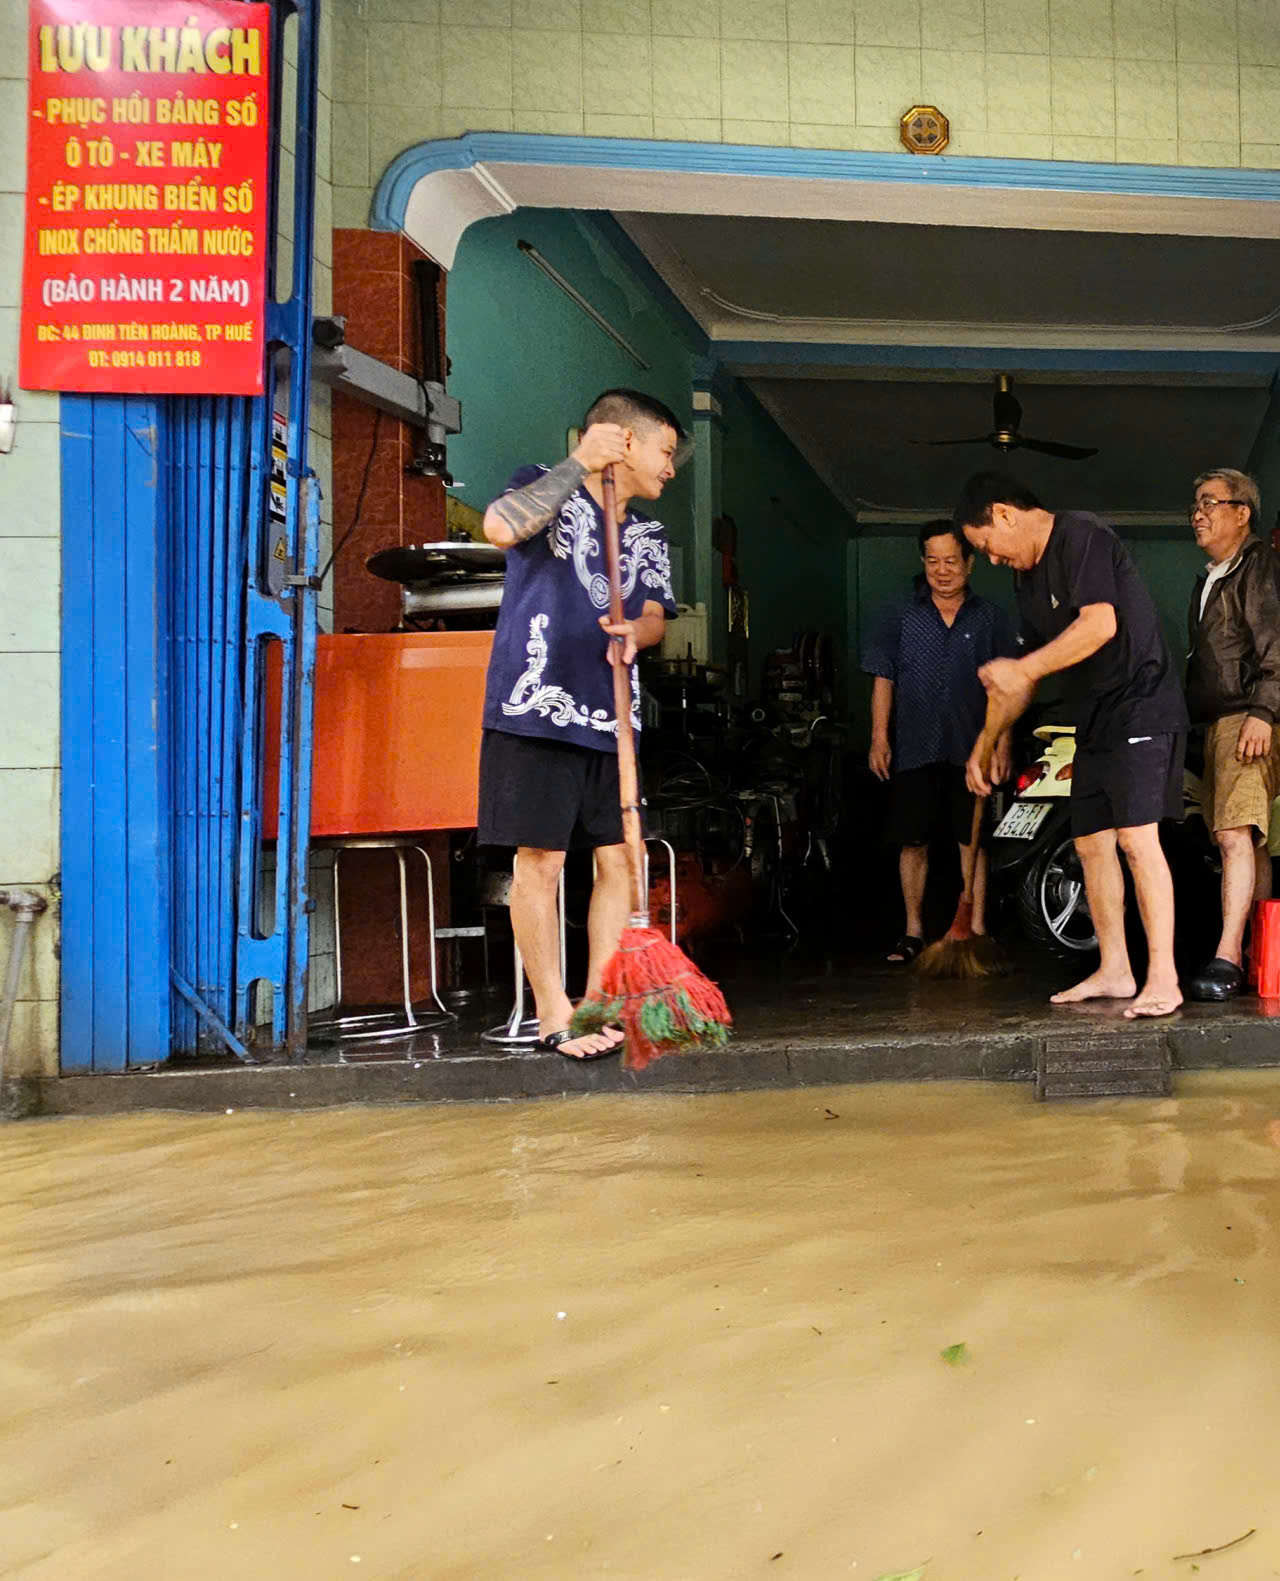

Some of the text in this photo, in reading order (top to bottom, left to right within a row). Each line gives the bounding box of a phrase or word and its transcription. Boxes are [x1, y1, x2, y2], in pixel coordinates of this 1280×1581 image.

[39, 16, 261, 75] LƯU KHÁCH
[47, 97, 106, 129] PHỤC
[112, 89, 150, 124] HỒI
[156, 90, 219, 125] BẢNG
[226, 92, 259, 127] SỐ
[65, 136, 82, 168] Ô
[87, 136, 115, 168] TÔ
[135, 141, 165, 168] XE
[171, 137, 223, 169] MÁY
[52, 180, 80, 212] ÉP
[84, 184, 158, 211] KHUNG
[164, 175, 217, 211] BIỂN
[223, 178, 254, 214] SỐ
[38, 219, 254, 256] INOX CHỐNG THẤM NƯỚC
[42, 273, 249, 307] (BẢO HÀNH 2 NĂM)
[118, 321, 149, 341] TIÊN
[205, 325, 223, 341] TP
[225, 320, 254, 342] HUẾ
[112, 350, 145, 368] 0914
[149, 351, 171, 368] 011
[175, 351, 201, 368] 818
